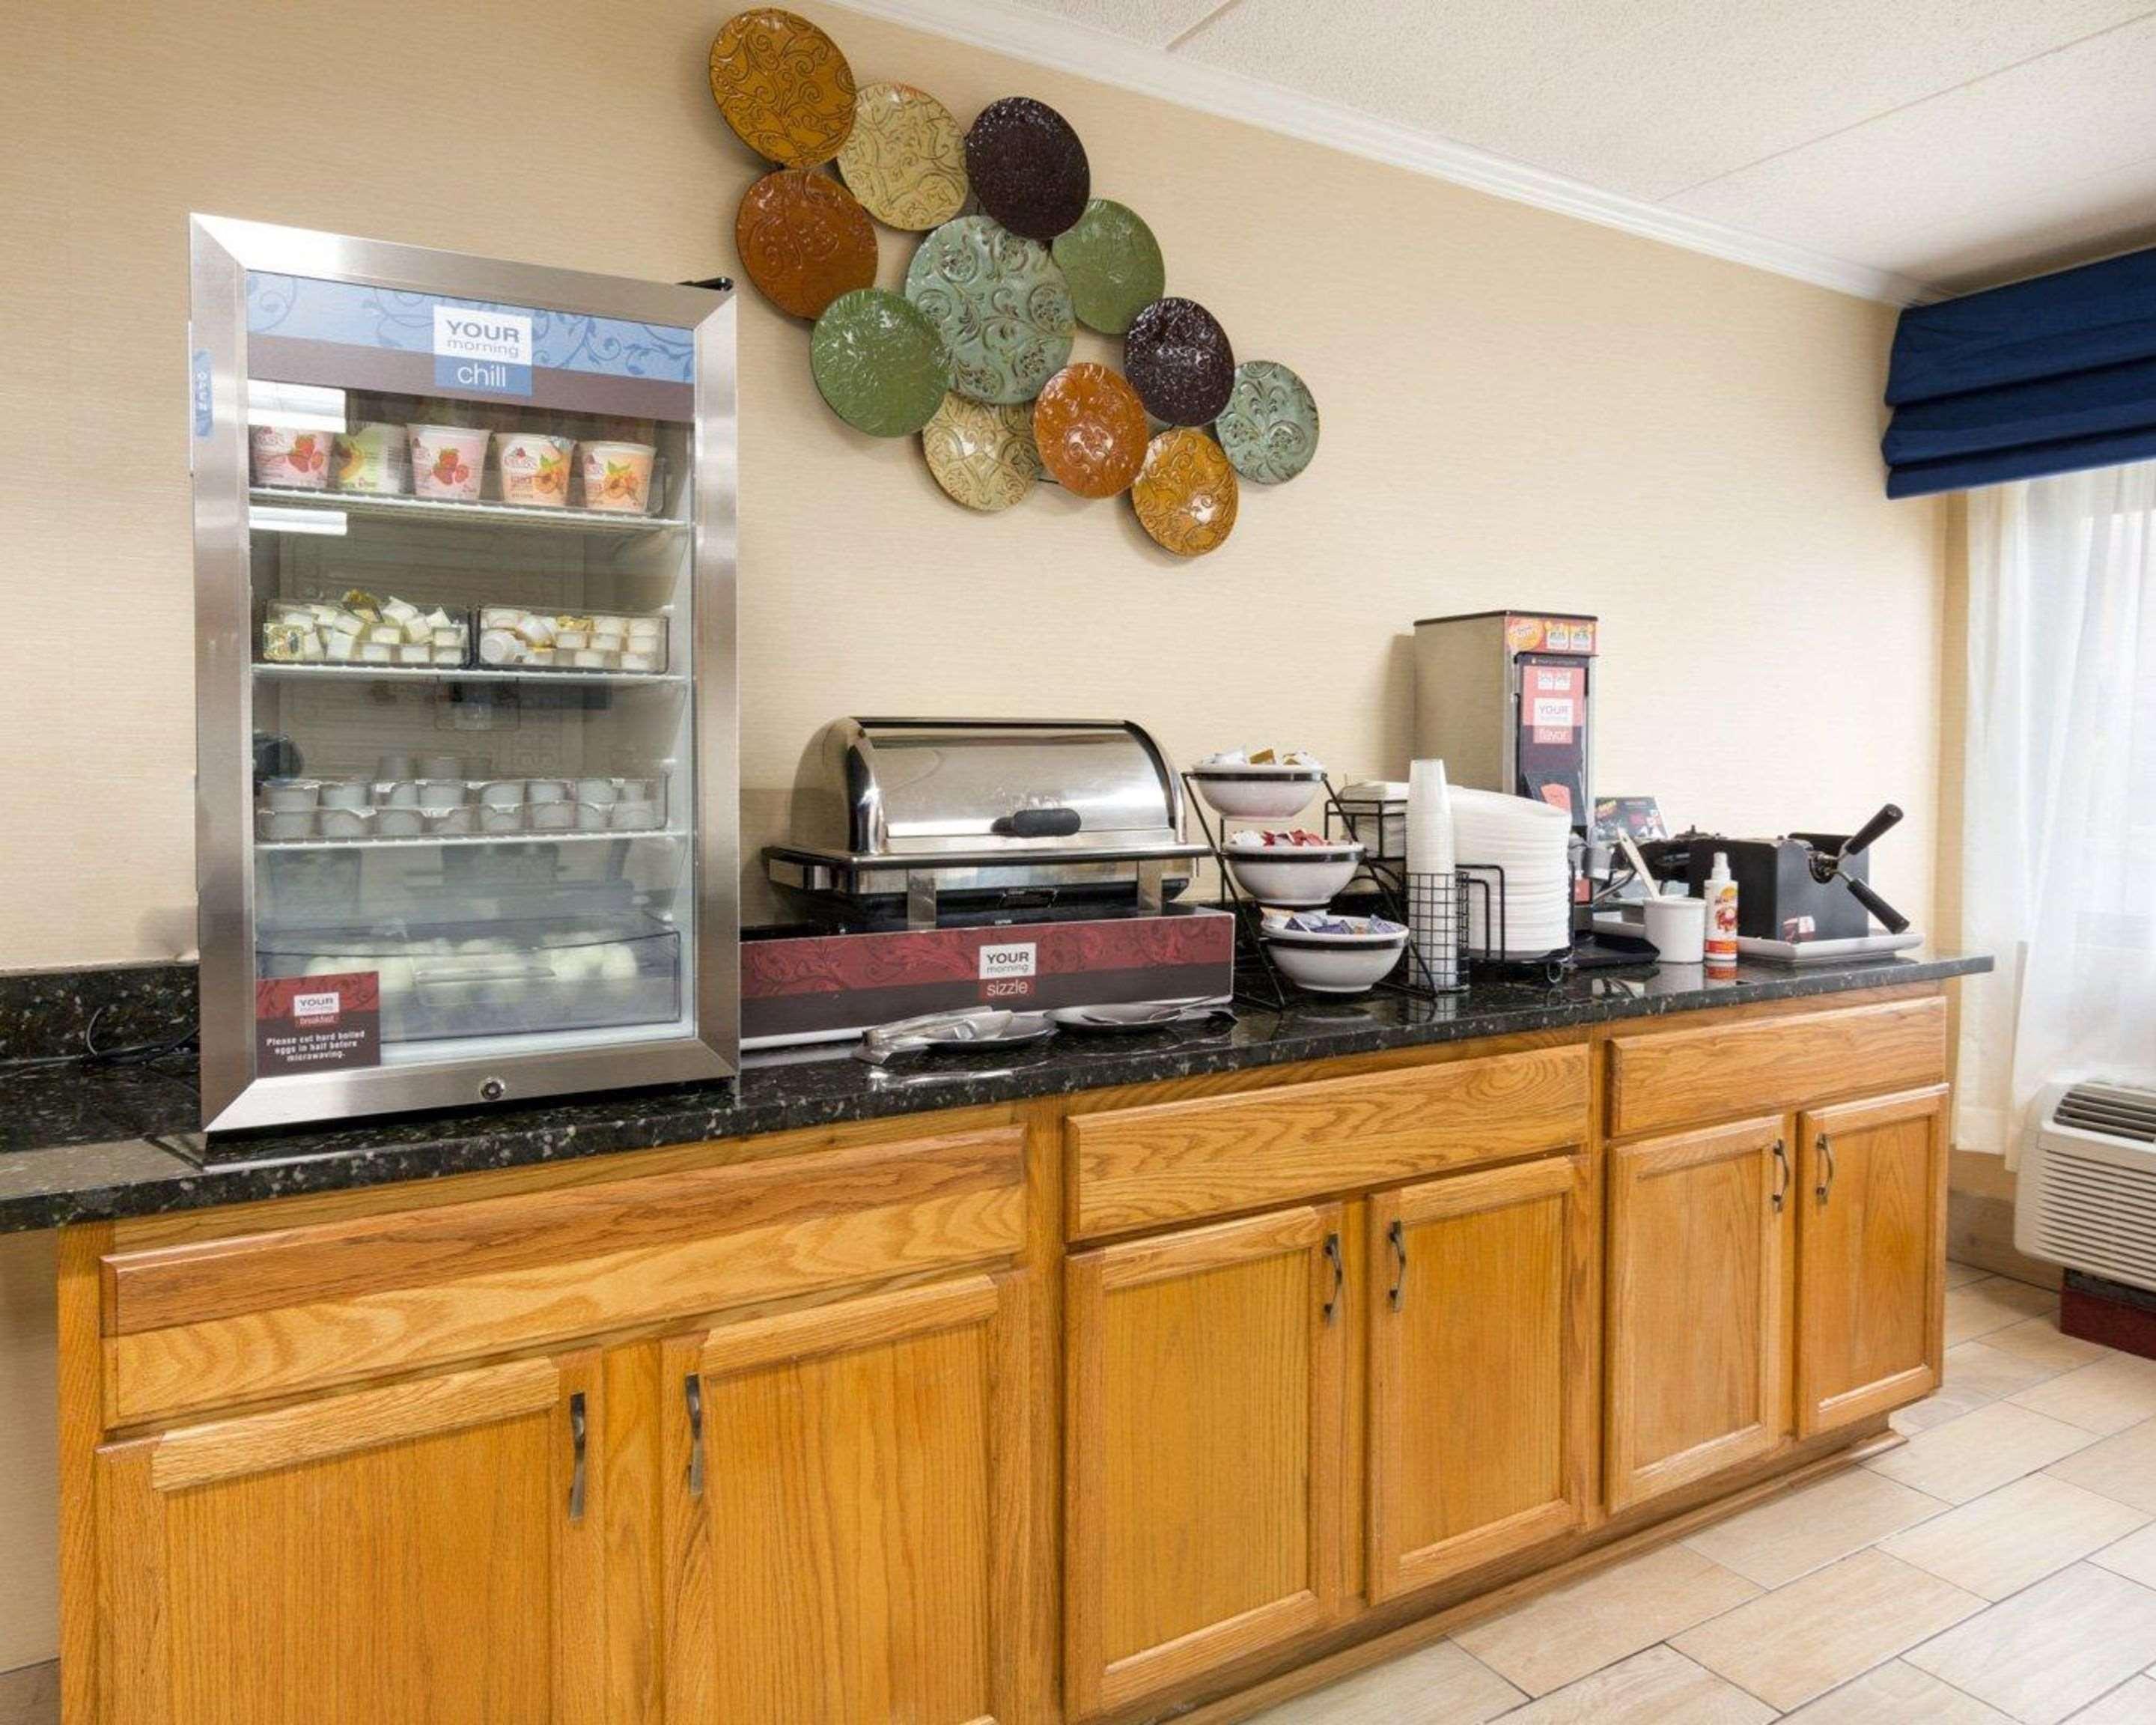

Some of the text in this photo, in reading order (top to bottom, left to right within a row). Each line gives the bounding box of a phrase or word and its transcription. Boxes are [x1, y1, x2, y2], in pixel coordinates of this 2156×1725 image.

[447, 320, 520, 342] YOUR
[447, 338, 519, 359] morning
[457, 363, 506, 387] chill
[1538, 705, 1569, 714] YOUR
[987, 952, 1029, 964] YOUR
[987, 964, 1029, 974] morning
[987, 979, 1028, 996] sizzle
[299, 997, 333, 1007] YOUR
[267, 1030, 365, 1046] Please cut hard boiled
[275, 1040, 357, 1056] eggs in half before
